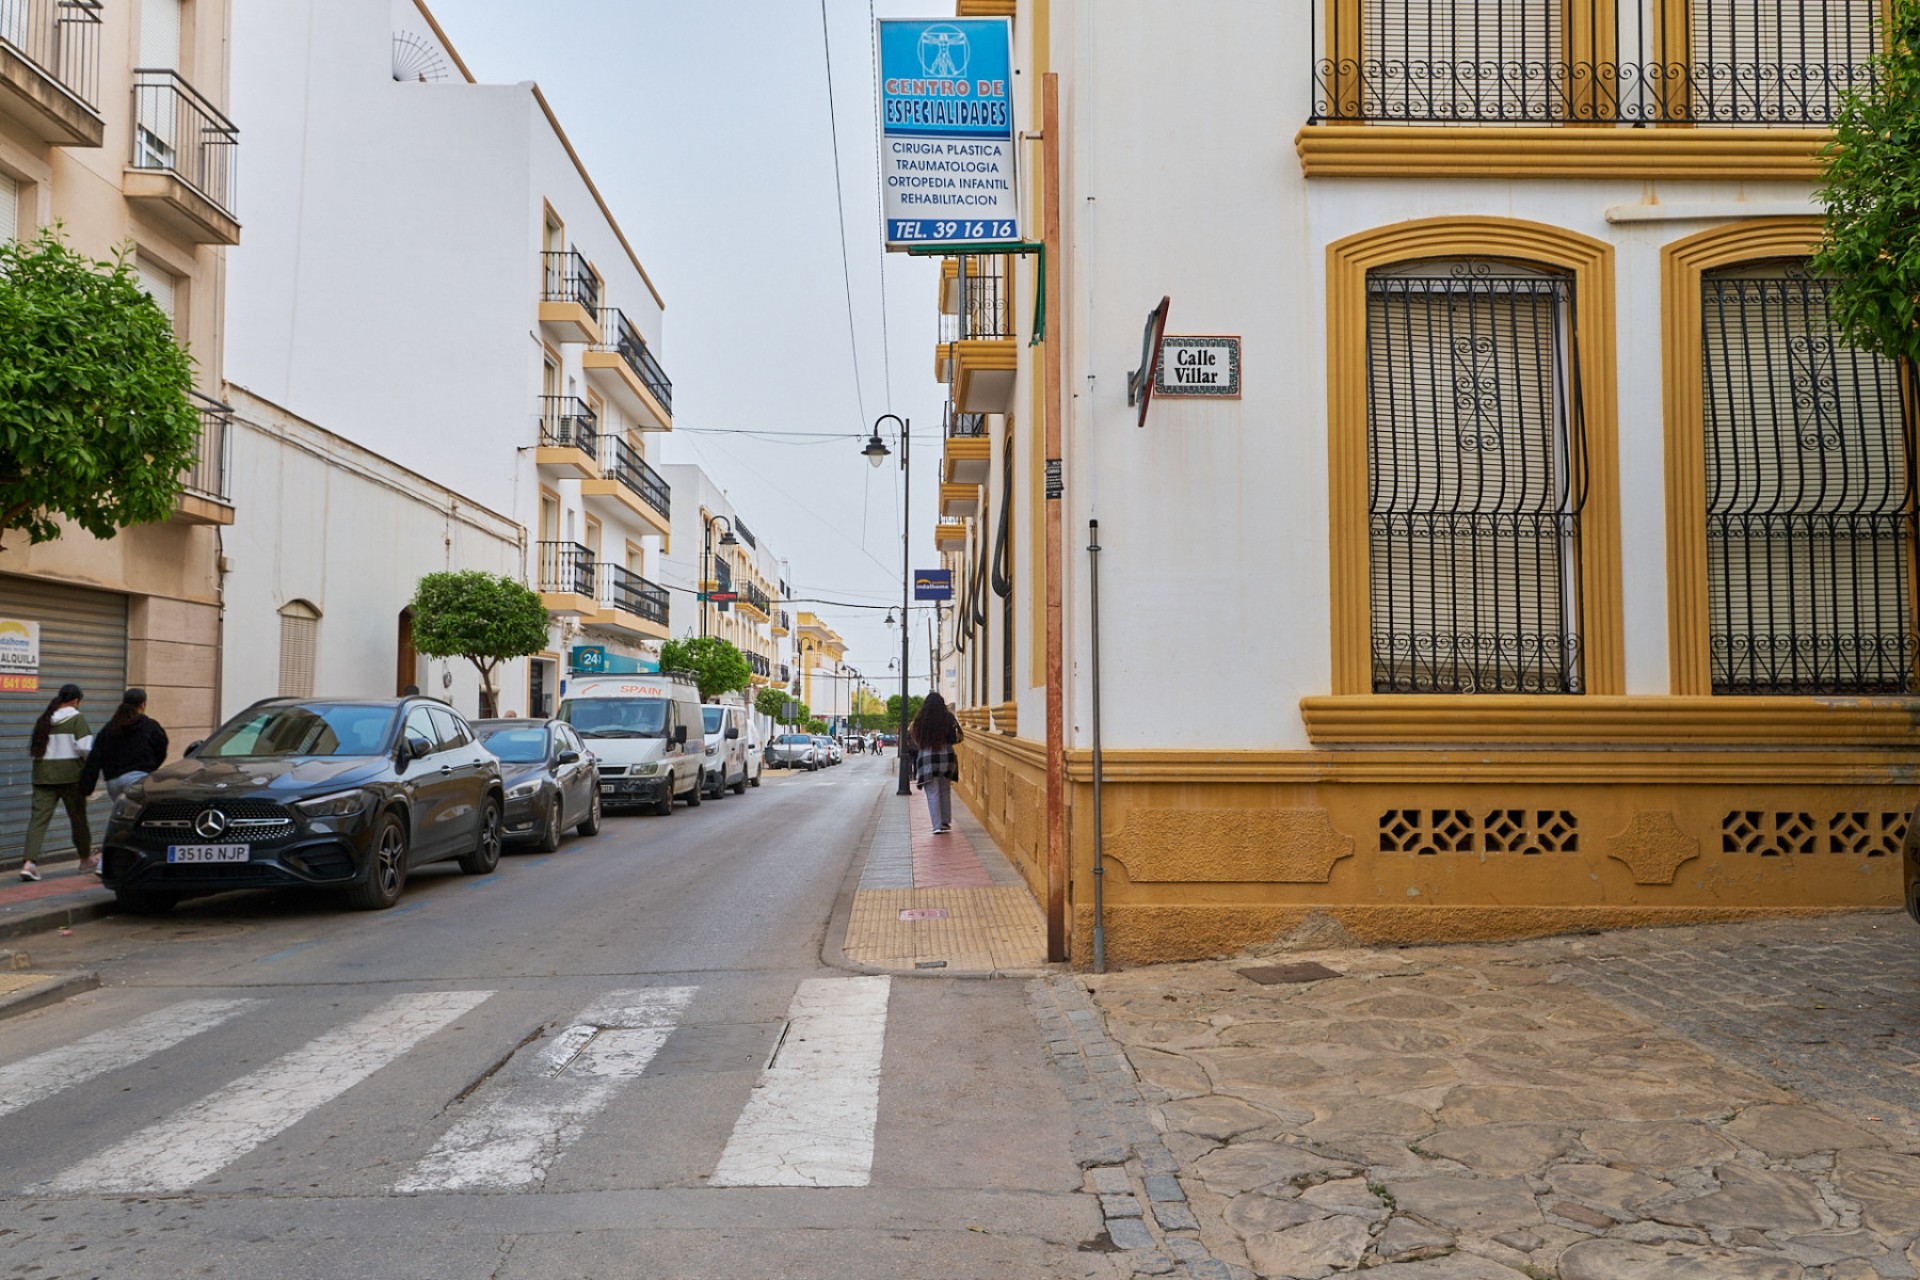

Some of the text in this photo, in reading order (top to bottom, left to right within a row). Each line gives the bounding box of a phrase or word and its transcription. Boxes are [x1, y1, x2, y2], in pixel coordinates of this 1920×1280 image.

[886, 79, 1004, 97] CENTRO DE
[886, 99, 1006, 126] ESPECIALIDADES
[892, 142, 1002, 156] CIRUGIA PLASTICA
[896, 160, 999, 173] TRAUMATOLOGIA
[888, 176, 1009, 190] ORTOPEDIA INFANTIL
[901, 193, 997, 205] REHABILITACION
[896, 220, 1011, 239] TEL. 39 16 16
[1177, 349, 1216, 366] Calle
[1174, 367, 1218, 384] Villar
[1, 653, 36, 664] ALQUILA
[620, 684, 662, 696] SPAIN
[178, 847, 246, 861] 3516 NJP
